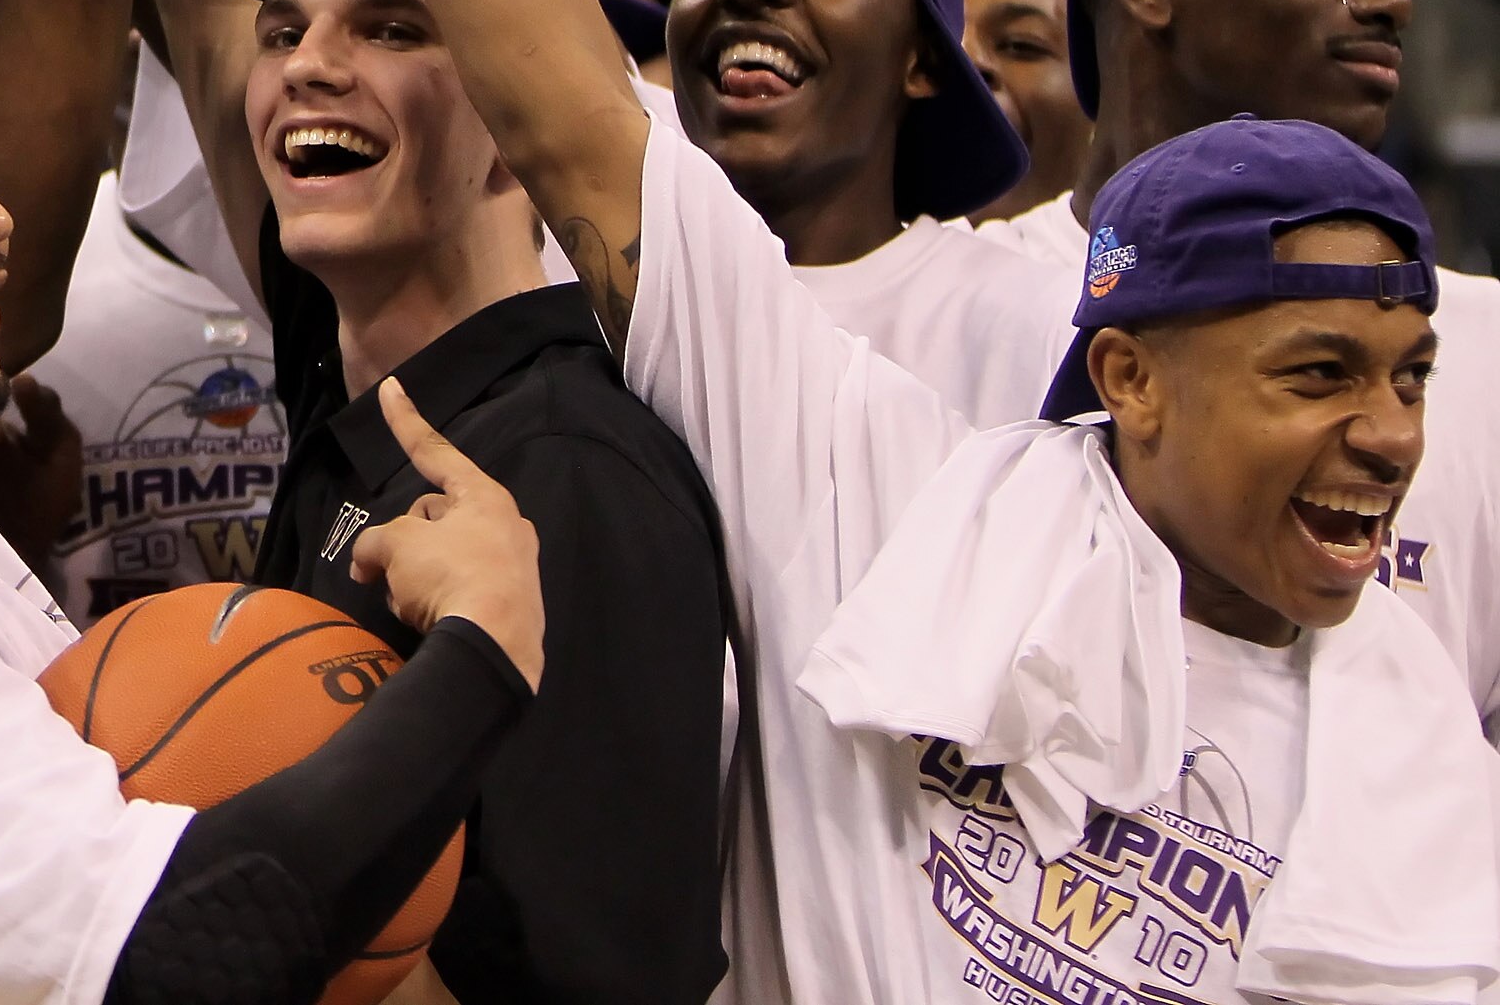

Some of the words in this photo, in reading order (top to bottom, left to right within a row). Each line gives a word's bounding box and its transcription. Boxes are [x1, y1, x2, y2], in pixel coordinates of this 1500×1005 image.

[110, 529, 180, 575] 20
[320, 500, 370, 563] W
[940, 874, 1141, 1005] WASHINGTO
[954, 813, 1026, 885] 20
[1031, 857, 1139, 954] W
[1133, 915, 1208, 988] 10
